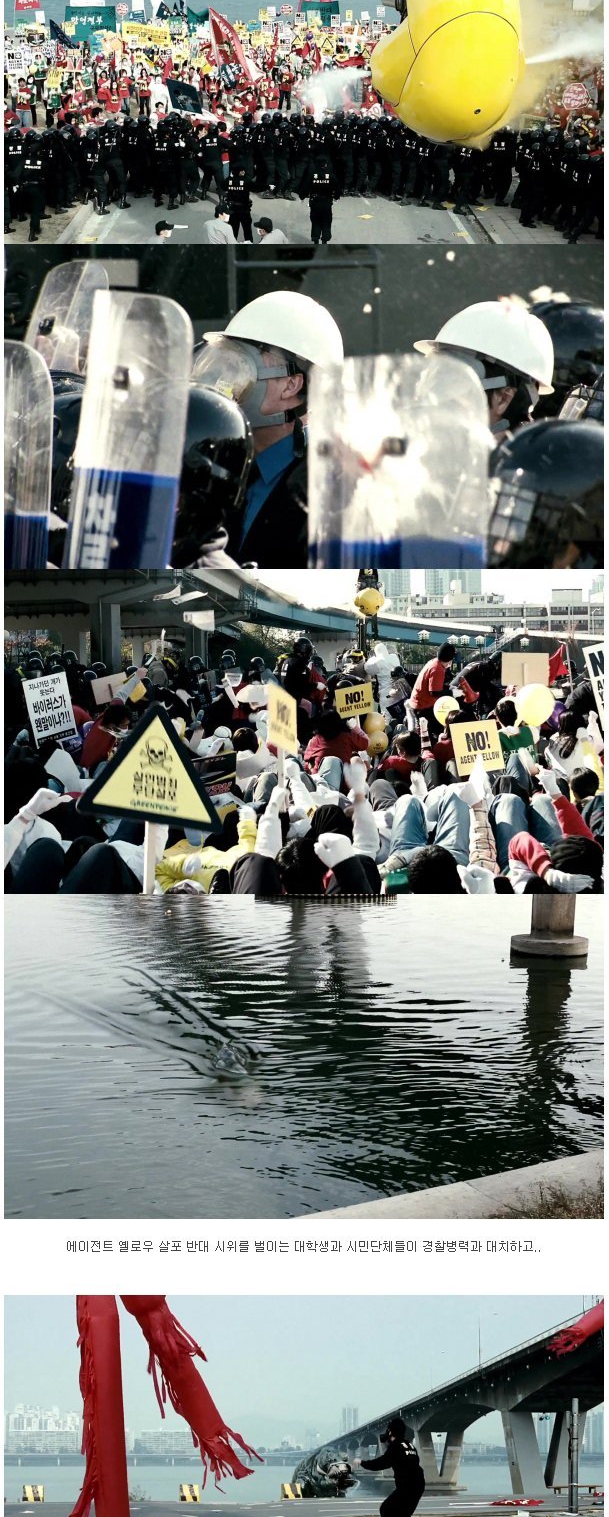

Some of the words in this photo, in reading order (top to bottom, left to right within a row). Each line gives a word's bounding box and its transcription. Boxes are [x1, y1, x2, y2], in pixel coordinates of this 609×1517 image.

[28, 679, 49, 690] 지나가던
[345, 690, 365, 705] NO!
[32, 694, 66, 715] 바이러스가
[339, 705, 353, 713] AGENT
[354, 702, 371, 710] YELLOW
[465, 731, 491, 752] NO!
[482, 751, 500, 761] ELLOW
